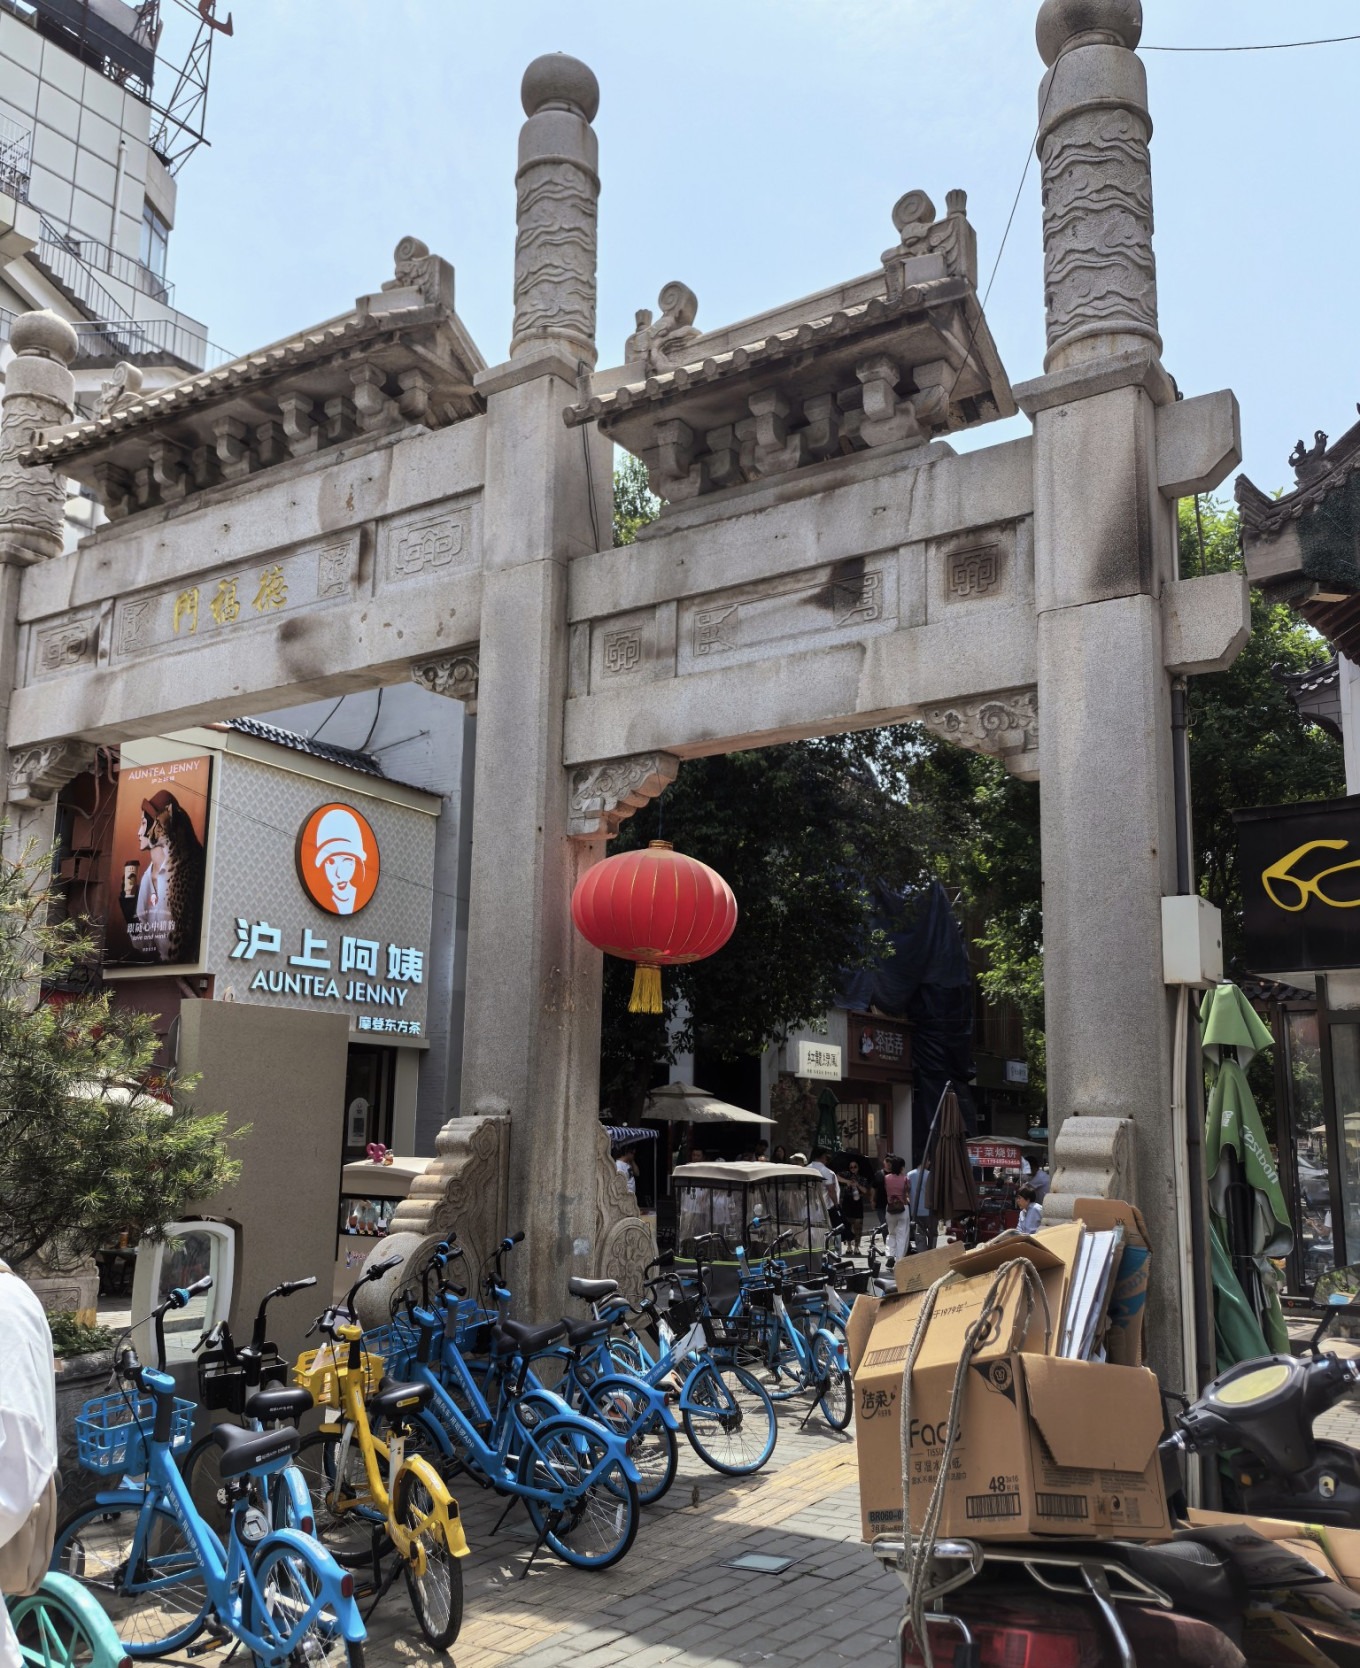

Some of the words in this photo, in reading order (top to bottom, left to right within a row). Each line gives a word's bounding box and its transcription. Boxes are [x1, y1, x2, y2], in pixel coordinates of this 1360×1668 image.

[128, 766, 165, 780] AUNTEA
[168, 760, 200, 775] JENNY
[228, 917, 424, 984] 沪上阿姨
[250, 969, 340, 999] AUNTEA
[345, 981, 409, 1007] JENNY
[357, 1015, 422, 1035] 摩登东方茶
[861, 1388, 890, 1414] 洁柔
[914, 1457, 962, 1473] 可湿水纸
[989, 1475, 1006, 1493] 48
[869, 1509, 904, 1521] BR060-0
